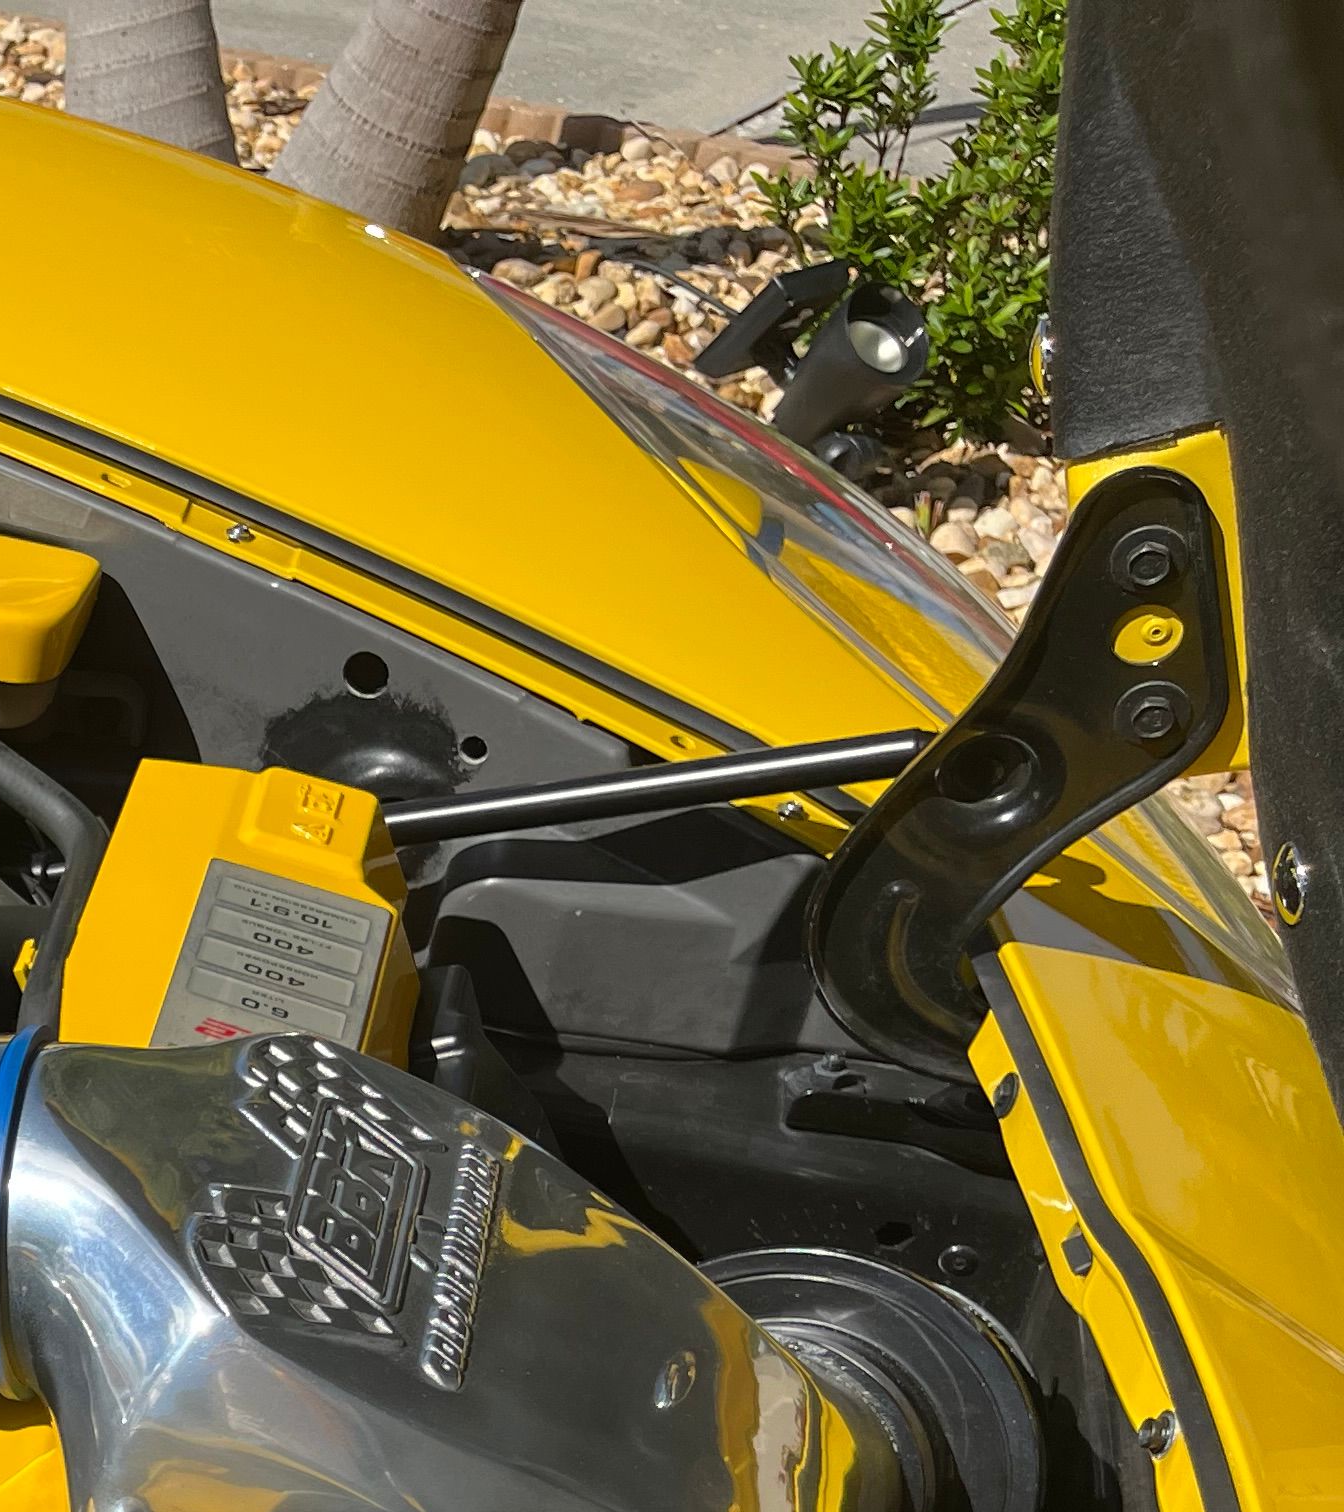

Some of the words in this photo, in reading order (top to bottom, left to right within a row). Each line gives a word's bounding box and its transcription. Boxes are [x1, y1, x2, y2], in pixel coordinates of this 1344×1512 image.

[250, 897, 333, 930] 10.9:1
[253, 931, 314, 955] 400
[243, 963, 305, 986] 400
[241, 997, 289, 1019] 6.0
